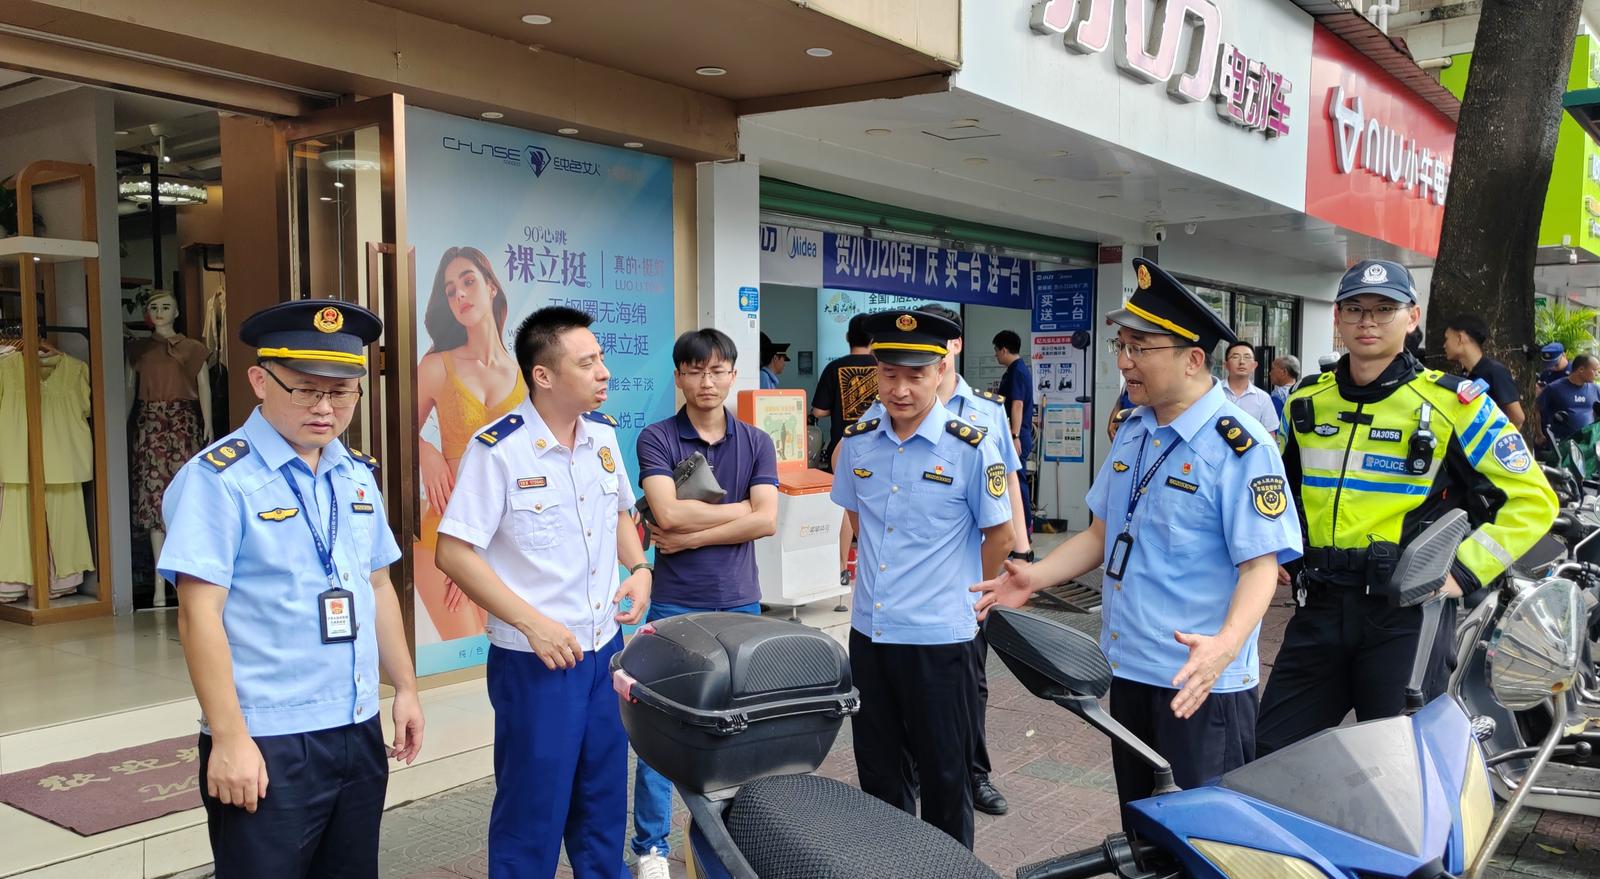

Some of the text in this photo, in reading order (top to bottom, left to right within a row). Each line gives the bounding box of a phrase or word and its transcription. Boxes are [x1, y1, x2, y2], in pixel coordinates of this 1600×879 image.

[1218, 43, 1293, 138] 电动车
[787, 227, 817, 259] Midea
[944, 249, 982, 291] 买一台
[987, 253, 1021, 297] 送一台
[1040, 291, 1085, 307] 买一台
[1039, 307, 1085, 321] 送一台
[1374, 458, 1405, 471] POLICE
